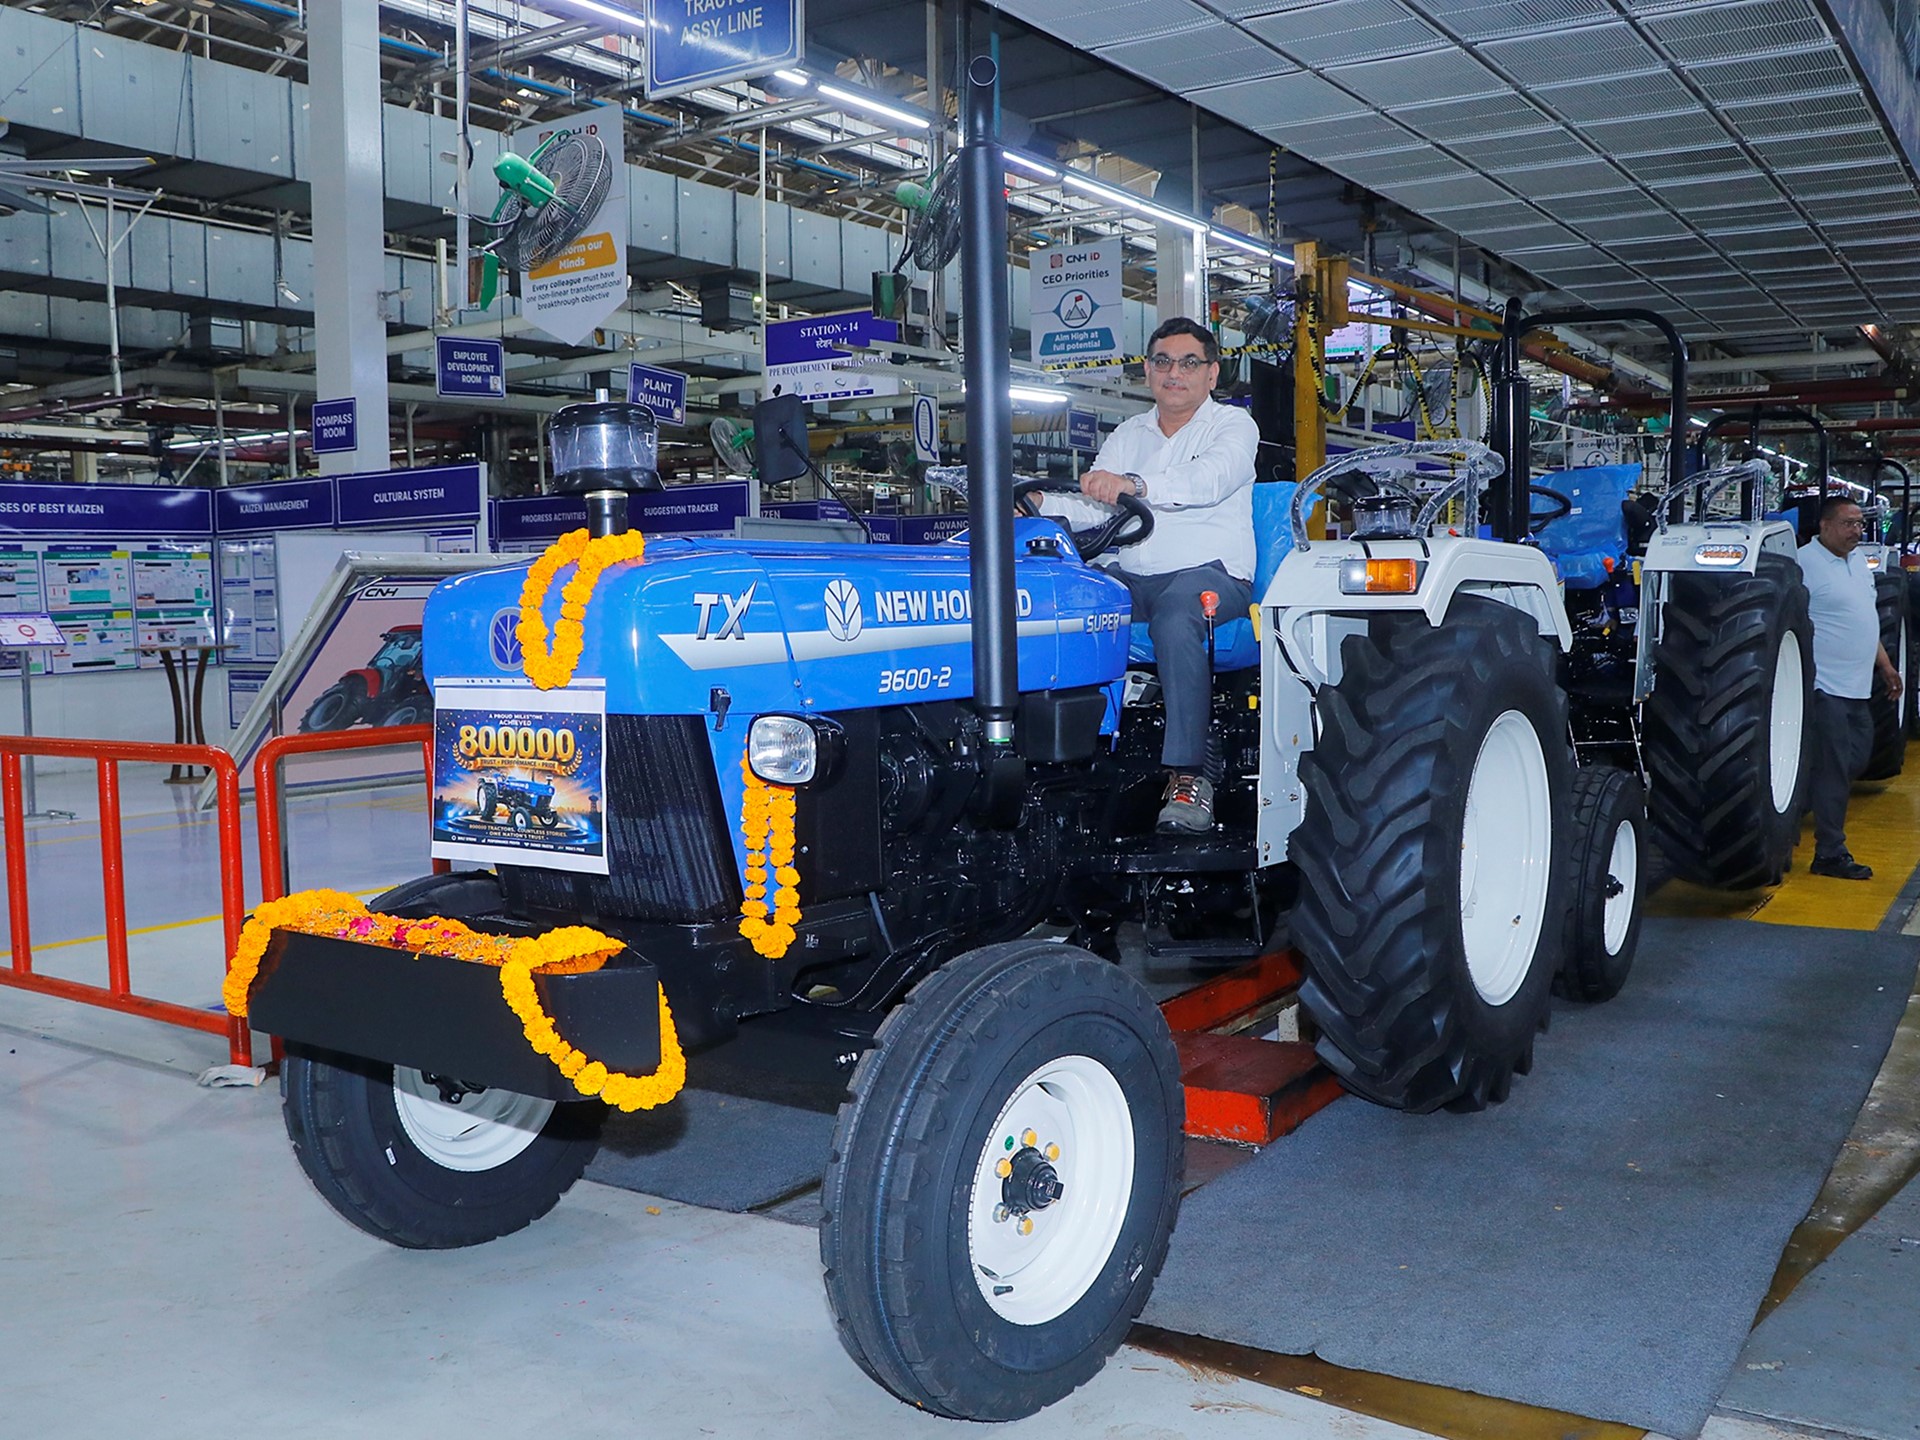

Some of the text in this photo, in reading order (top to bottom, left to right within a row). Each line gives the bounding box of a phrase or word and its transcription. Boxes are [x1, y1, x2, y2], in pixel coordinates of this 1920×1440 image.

[680, 7, 763, 46] ASSY. LINE
[587, 241, 603, 251] our
[559, 257, 586, 270] Minds
[1066, 253, 1087, 264] CNH
[532, 270, 615, 293] Every colleague must have
[1042, 269, 1110, 285] CEO Priorities
[538, 290, 569, 301] non-linear
[570, 278, 622, 294] transformational
[537, 291, 610, 310] breakthrough objective
[800, 324, 842, 338] STATION
[849, 322, 859, 331] 14
[1054, 333, 1069, 342] Aim
[1071, 332, 1089, 341] High
[1053, 340, 1101, 351] full potential
[453, 350, 488, 362] EMPLOYEE
[447, 361, 495, 373] DEVELOPMENT
[769, 367, 780, 377] PPE
[781, 363, 830, 376] REQUIREMENT
[461, 374, 482, 384] ROOM
[643, 378, 673, 394] PLANT
[638, 393, 676, 410] QUALITY
[316, 413, 353, 427] COMPASS
[323, 426, 346, 438] ROOM
[373, 487, 445, 503] CULTURAL SYSTEM
[22, 503, 37, 513] OF
[39, 503, 65, 514] BEST
[67, 504, 104, 514] KAIZEN
[240, 499, 309, 514] KAIZEN MANAGEMENT
[644, 503, 719, 516] SUGGESTION TRACKER
[521, 511, 587, 523] PROGRESS ACTIVITIES
[365, 587, 399, 597] CNH
[692, 578, 757, 640] TX
[874, 590, 927, 623] NEW
[1086, 612, 1120, 634] SUPER
[878, 665, 952, 694] 3600-2
[459, 725, 575, 762] 800000
